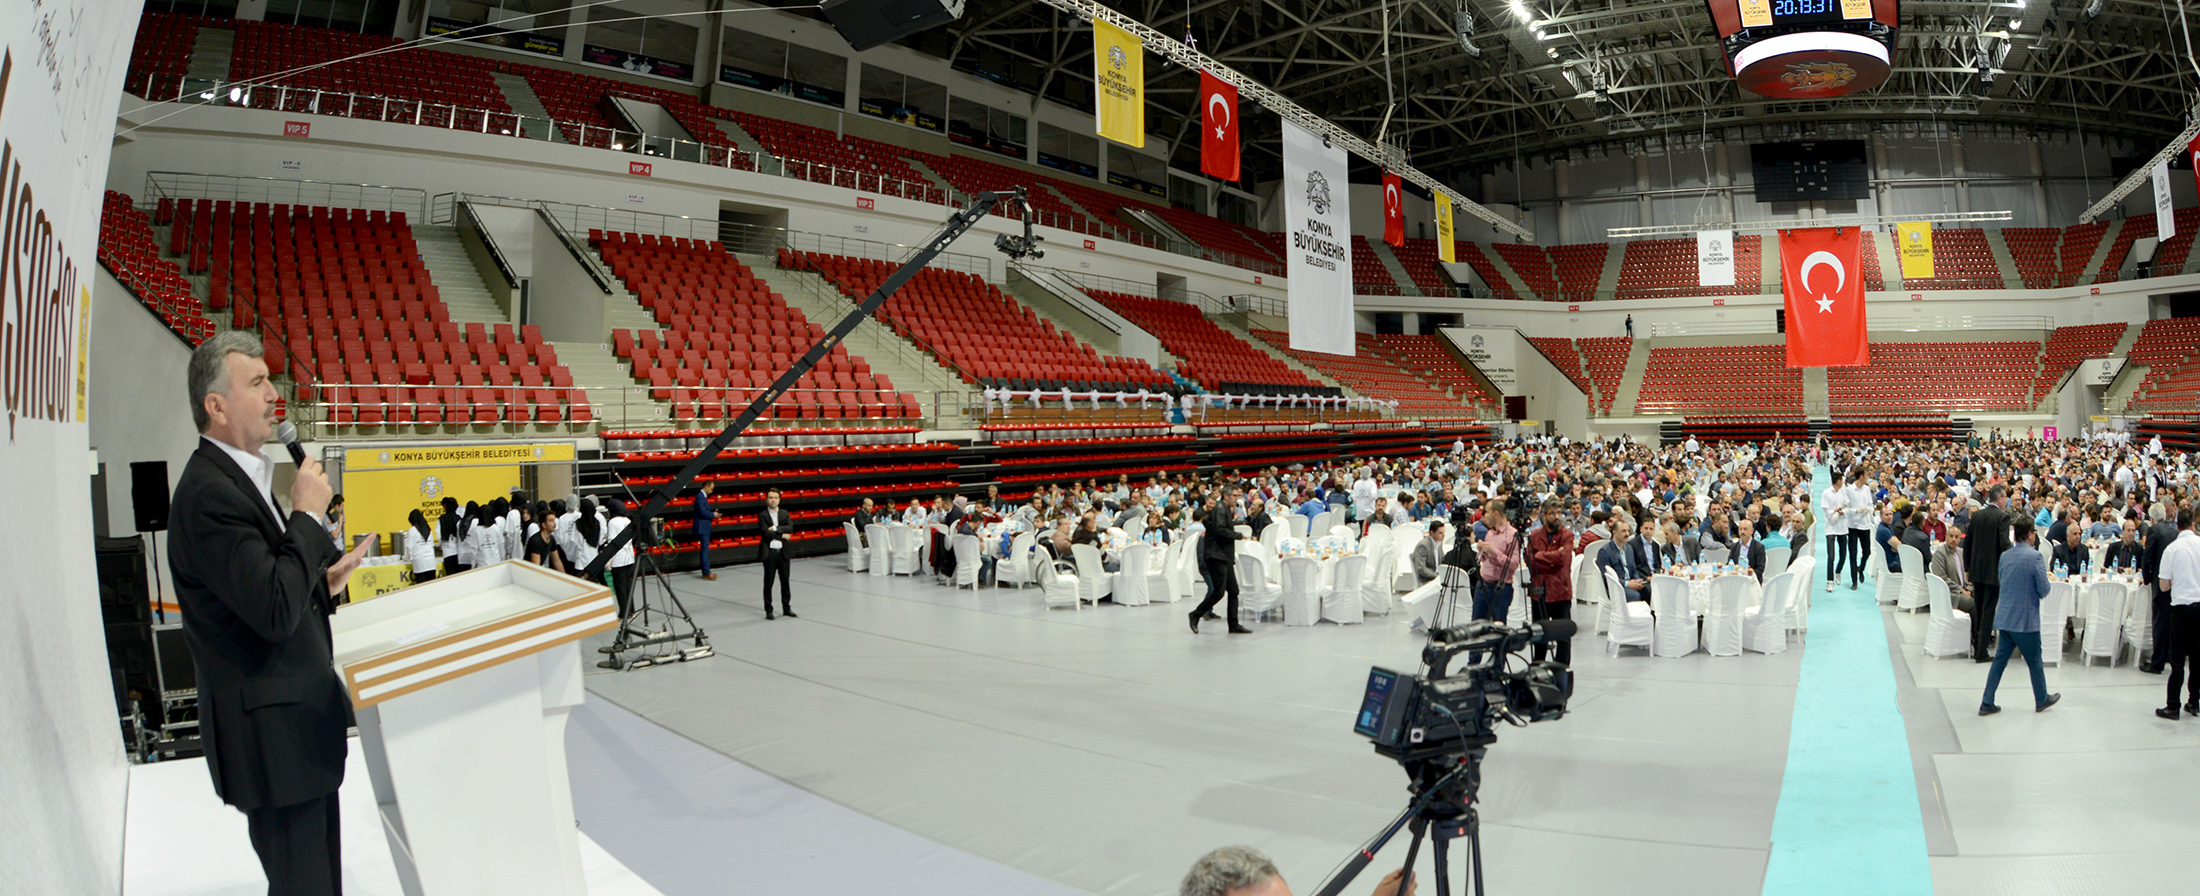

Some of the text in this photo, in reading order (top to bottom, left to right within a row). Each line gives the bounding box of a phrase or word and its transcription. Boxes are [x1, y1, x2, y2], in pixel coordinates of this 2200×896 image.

[1775, 0, 1833, 15] 20:13:31
[1107, 70, 1127, 83] KONYA
[287, 124, 308, 134] VIP 5
[631, 164, 643, 173] VIP
[1307, 218, 1333, 239] KONYA
[1293, 229, 1346, 262] BÜYÜKŞEHİR
[1305, 254, 1337, 273] BELEDİYESİ
[394, 448, 531, 461] KONYA BÜYÜKŞEHİR BELEDİYESİ
